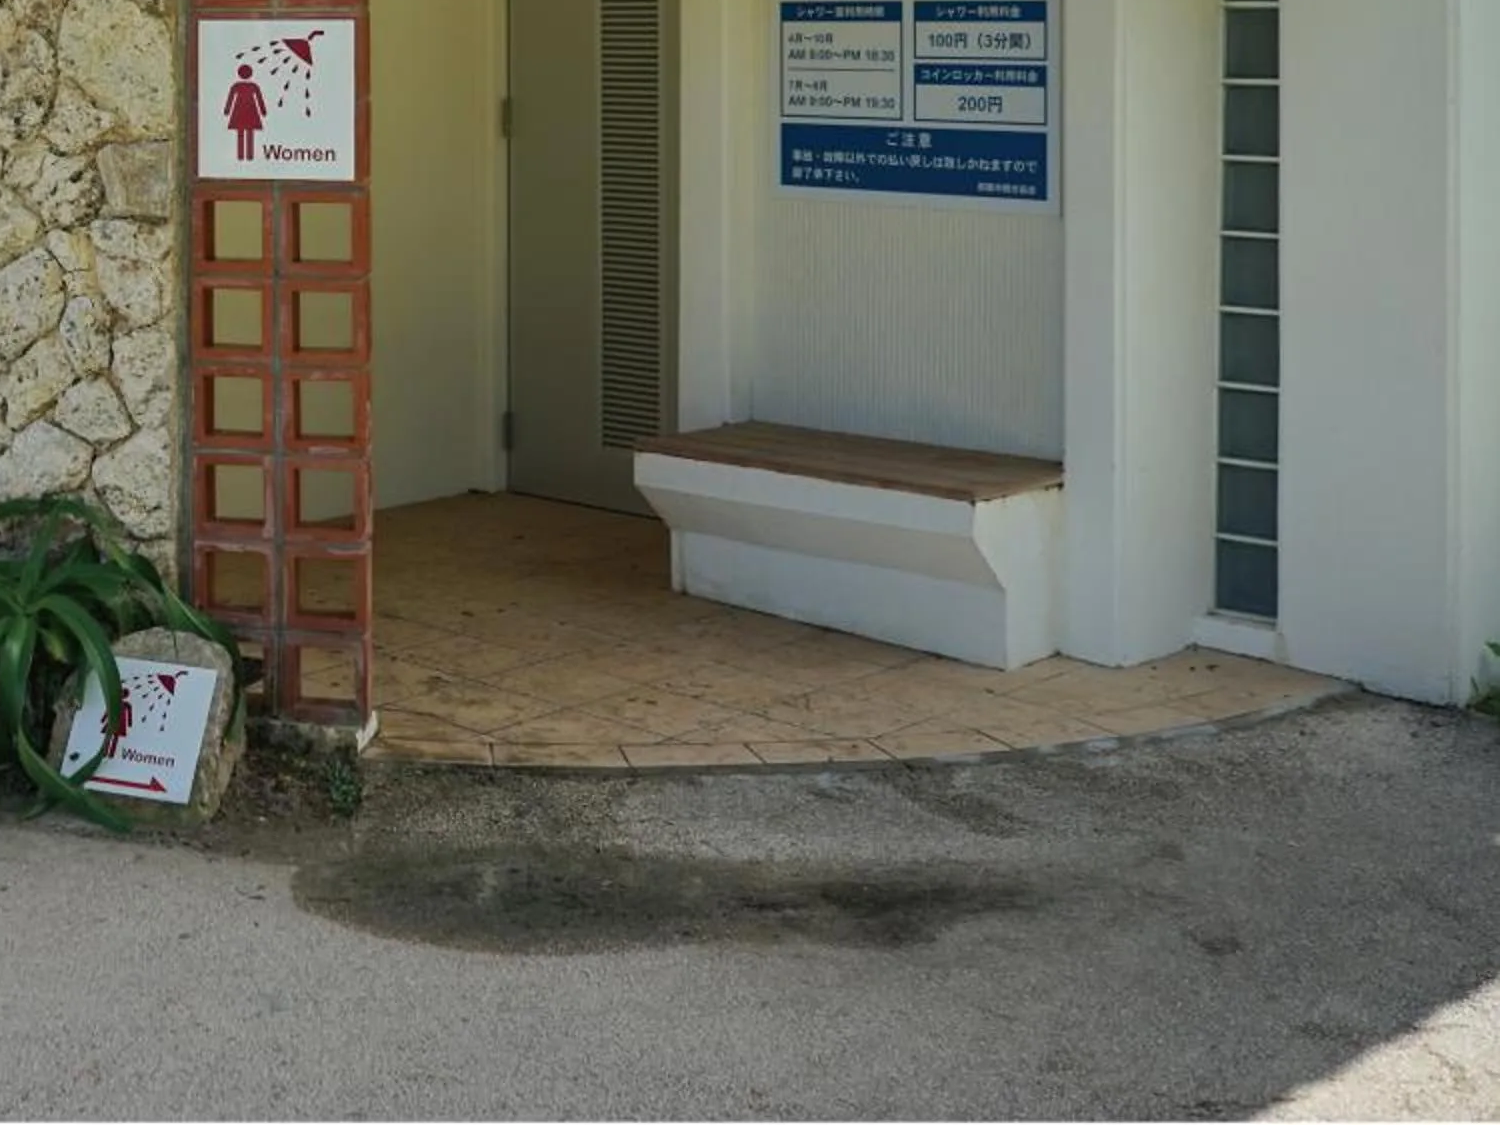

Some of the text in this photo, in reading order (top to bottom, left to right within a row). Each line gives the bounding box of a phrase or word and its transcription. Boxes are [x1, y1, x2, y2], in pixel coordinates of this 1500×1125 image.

[957, 95, 1003, 113] 200円
[886, 131, 933, 149] ご注意
[263, 145, 336, 161] Women
[122, 747, 175, 767] Women
